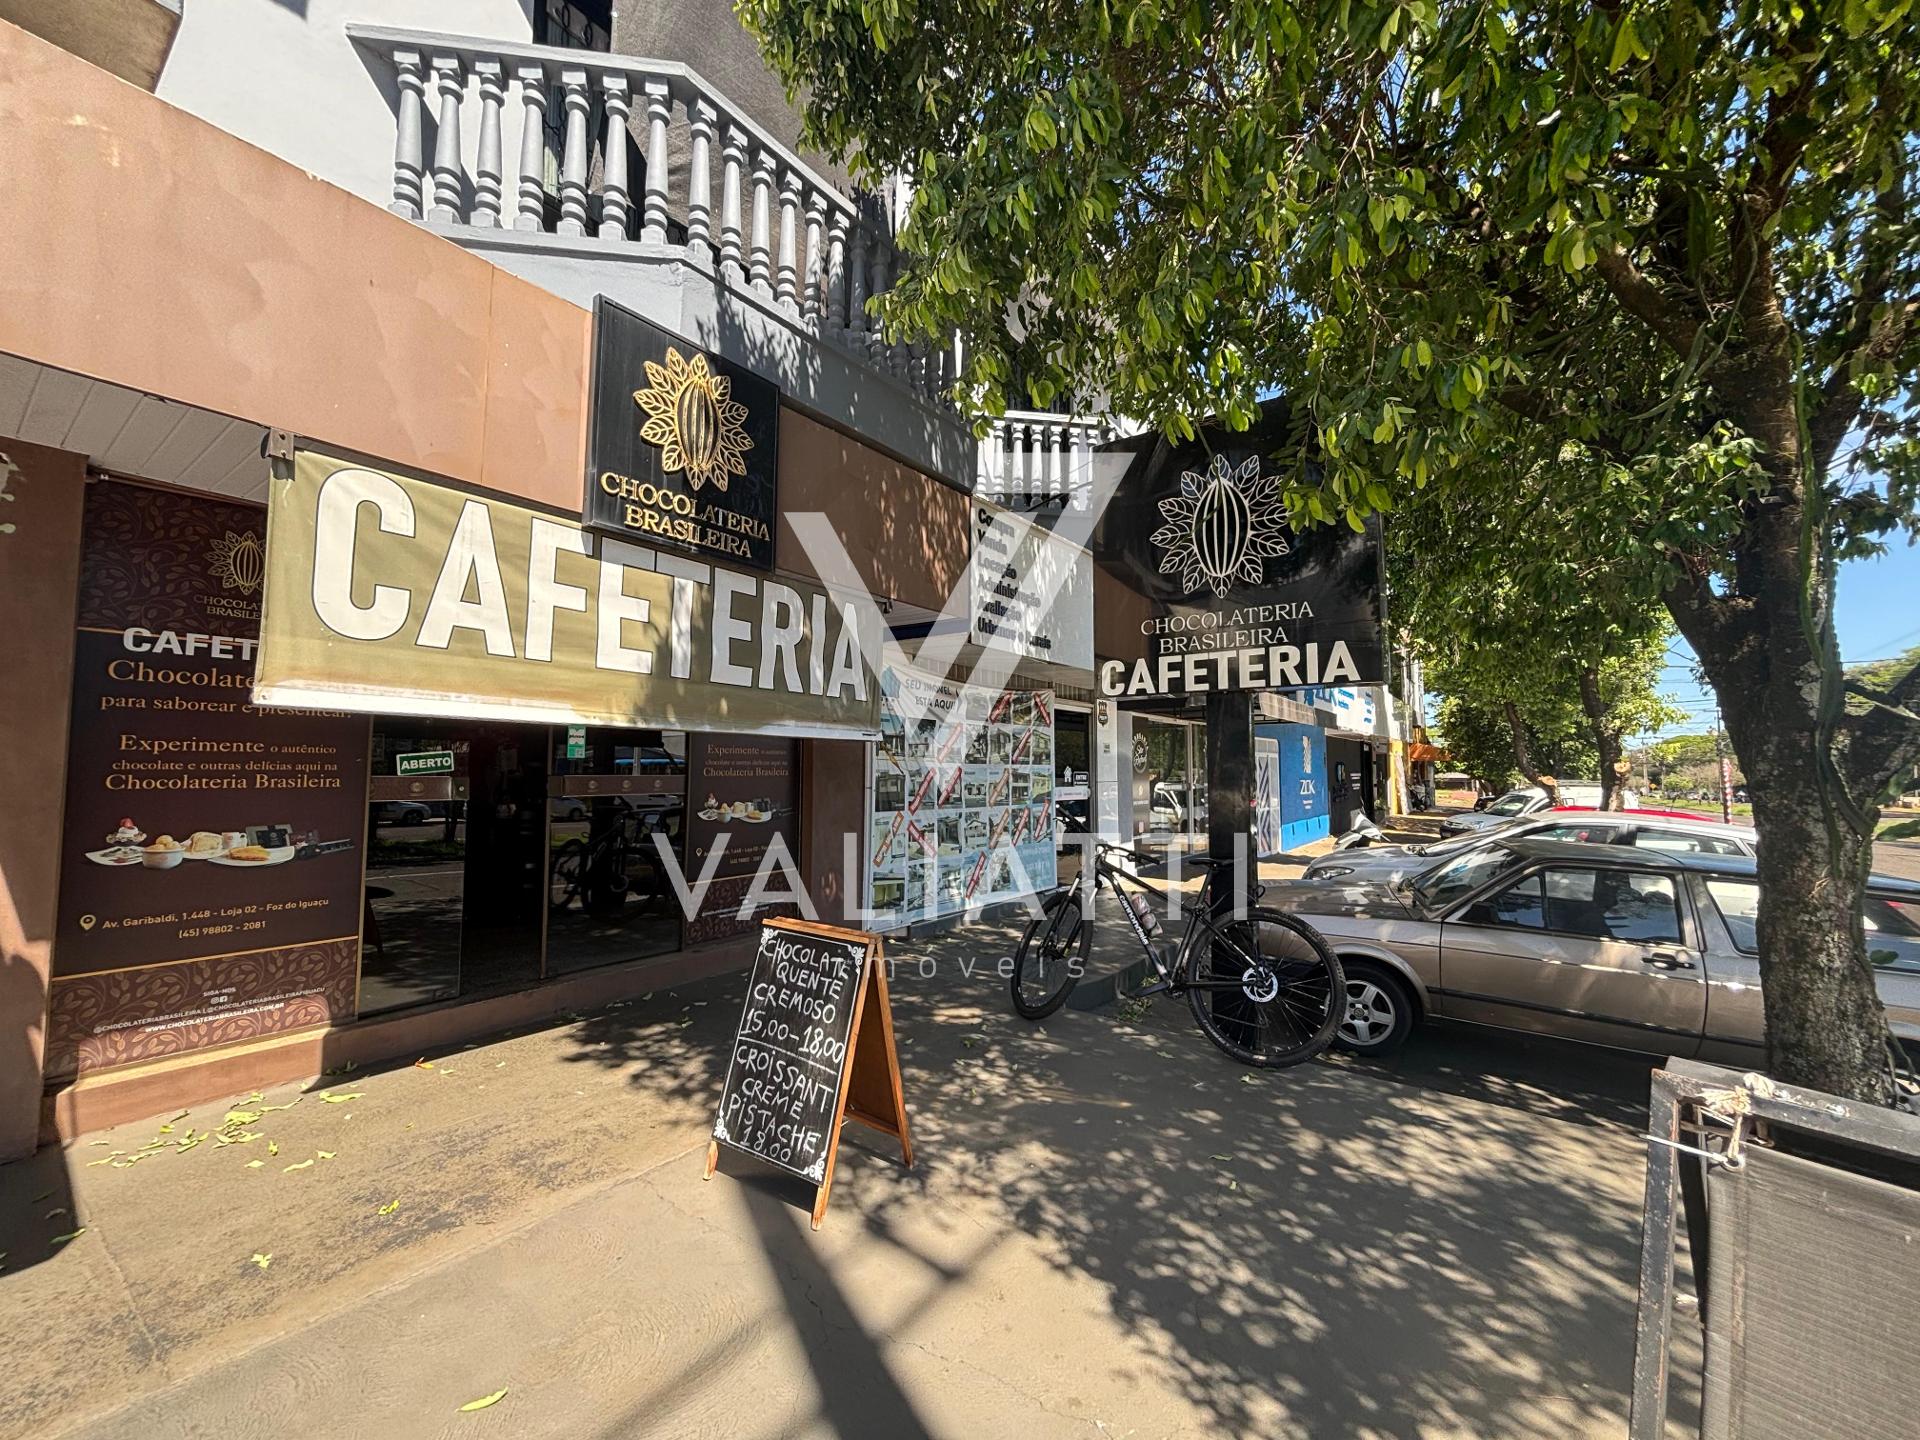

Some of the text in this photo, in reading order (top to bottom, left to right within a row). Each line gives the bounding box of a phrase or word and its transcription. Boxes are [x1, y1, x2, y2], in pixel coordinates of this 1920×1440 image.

[600, 471, 771, 542] CHOCOLATERIA
[624, 504, 752, 558] BRASILEIRA
[310, 467, 869, 702] CAFETERIA
[206, 605, 263, 621] BRASILE
[1141, 600, 1314, 636] CHOCOLATERIA
[123, 627, 259, 660] CAFET
[1159, 625, 1289, 654] BRASILEIRA
[1101, 640, 1361, 696] CAFETERIA
[101, 696, 146, 710] para
[153, 695, 237, 713] saborear
[119, 734, 337, 755] Experimente o autêntico
[707, 743, 760, 756] Experimente
[112, 759, 338, 773] chocolate e outras delícias aqui na
[400, 755, 451, 771] ABERTO
[105, 772, 341, 790] Chocolateria Brasileira
[102, 920, 119, 929] Av.
[182, 909, 211, 920] 1.448
[220, 906, 242, 917] Loja
[244, 905, 257, 914] 02
[266, 903, 283, 912] Foz
[285, 901, 297, 910] do
[299, 898, 329, 910] Iguaçu
[178, 927, 200, 939] (45)
[202, 924, 233, 936] 98802
[243, 920, 266, 931] 2081
[763, 938, 851, 980] CHOCOLATE
[776, 961, 844, 999] QUENTE
[753, 983, 836, 1024] CREMOSO
[741, 1077, 804, 1121] CREME
[739, 1125, 792, 1163] 18,00
